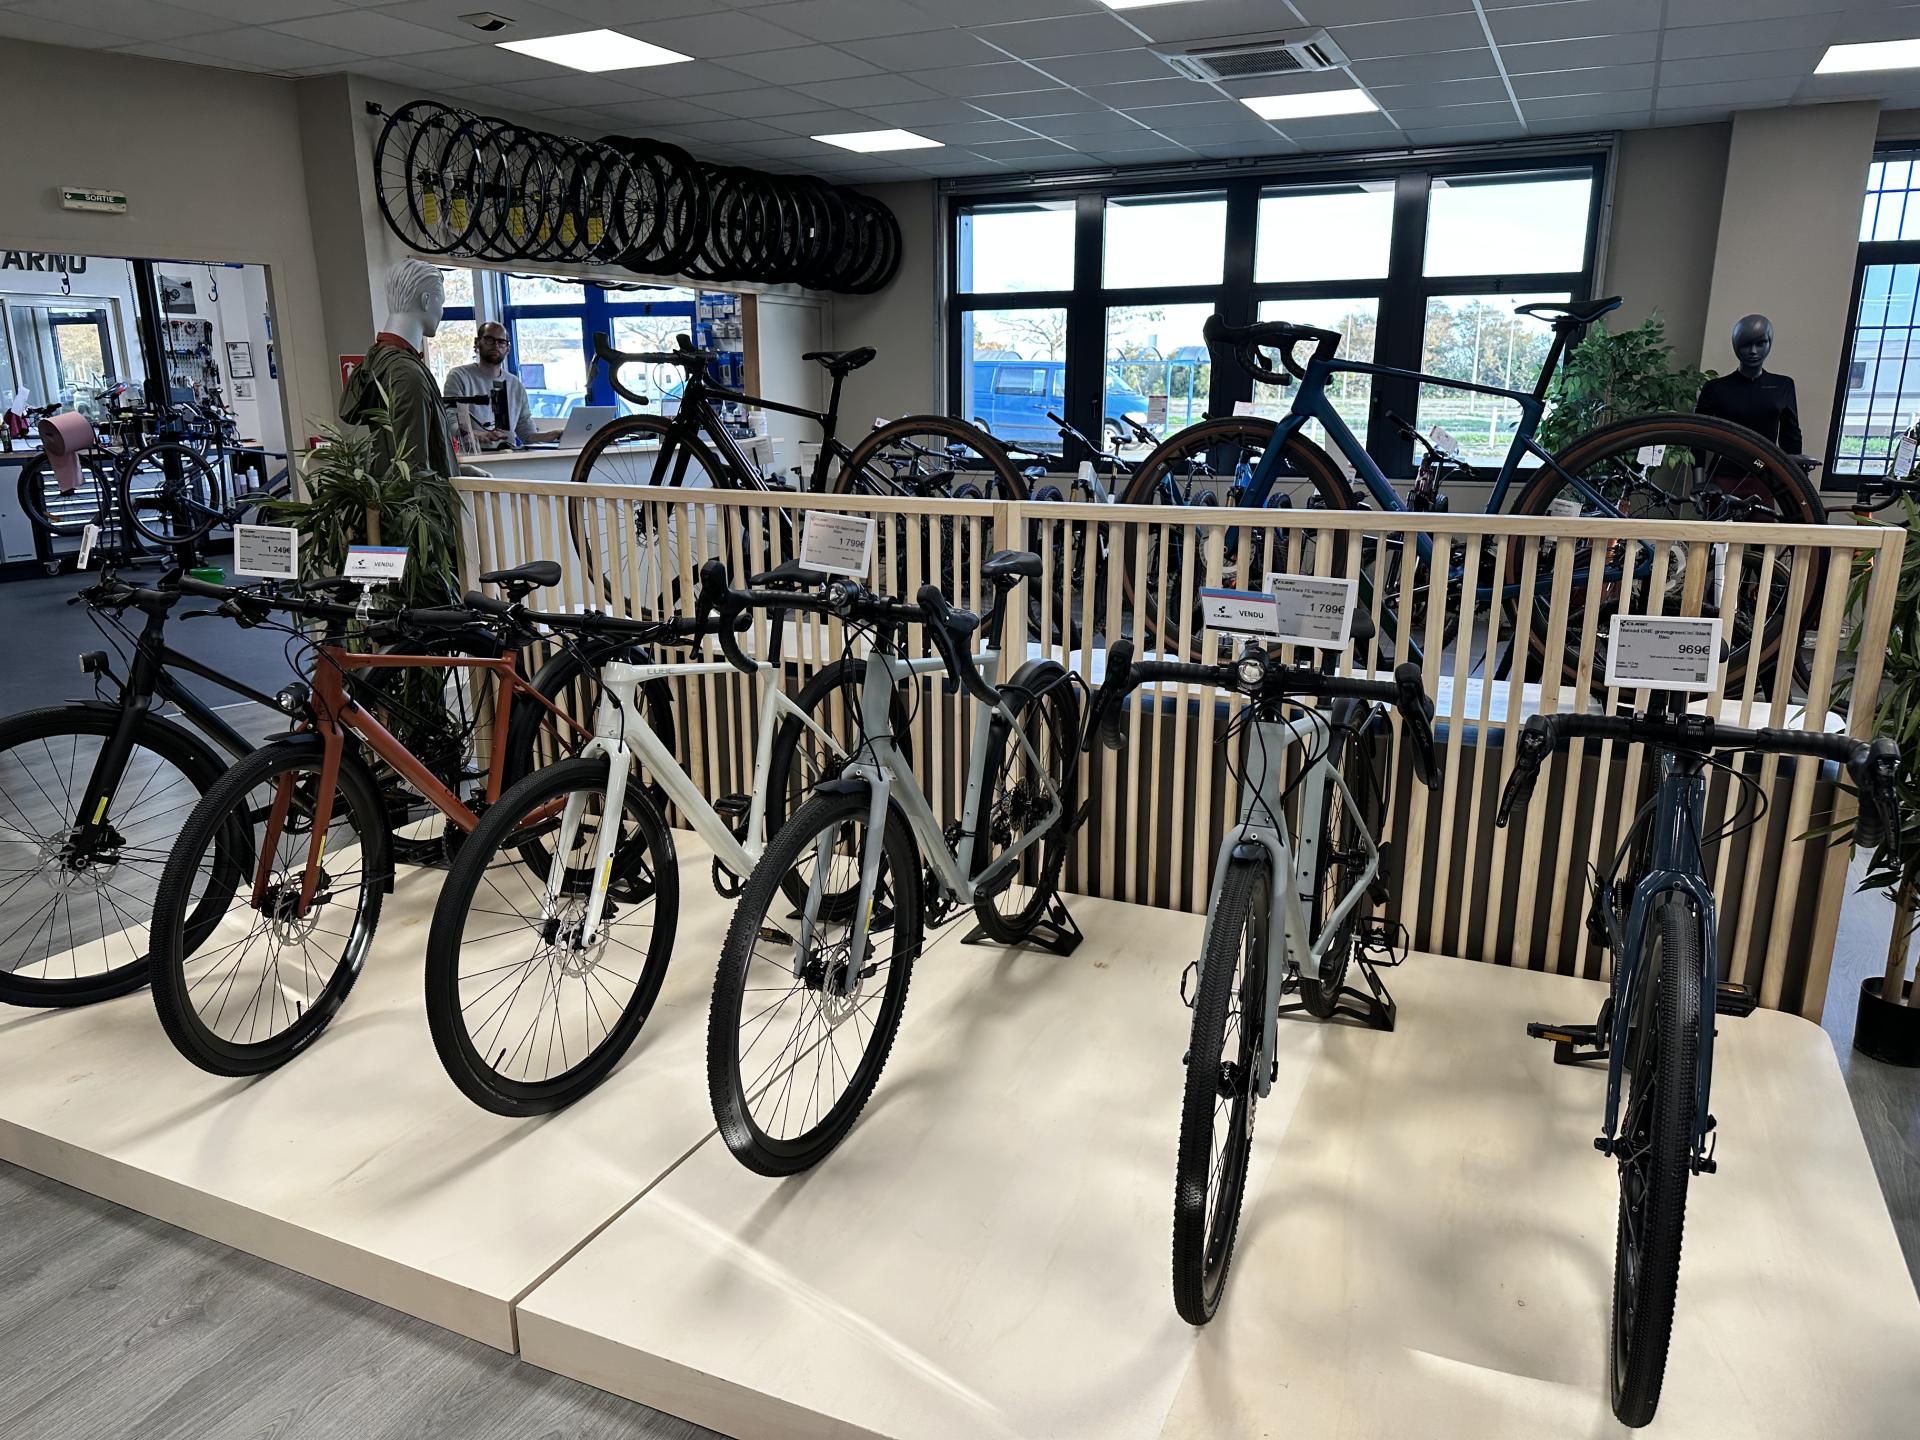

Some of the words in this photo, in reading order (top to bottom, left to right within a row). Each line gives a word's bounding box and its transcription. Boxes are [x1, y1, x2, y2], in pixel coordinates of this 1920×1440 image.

[85, 195, 114, 203] SORTIE
[846, 538, 865, 549] 799€
[1319, 603, 1345, 614] 799€
[1239, 610, 1264, 619] VENDU
[1678, 644, 1710, 655] 969€
